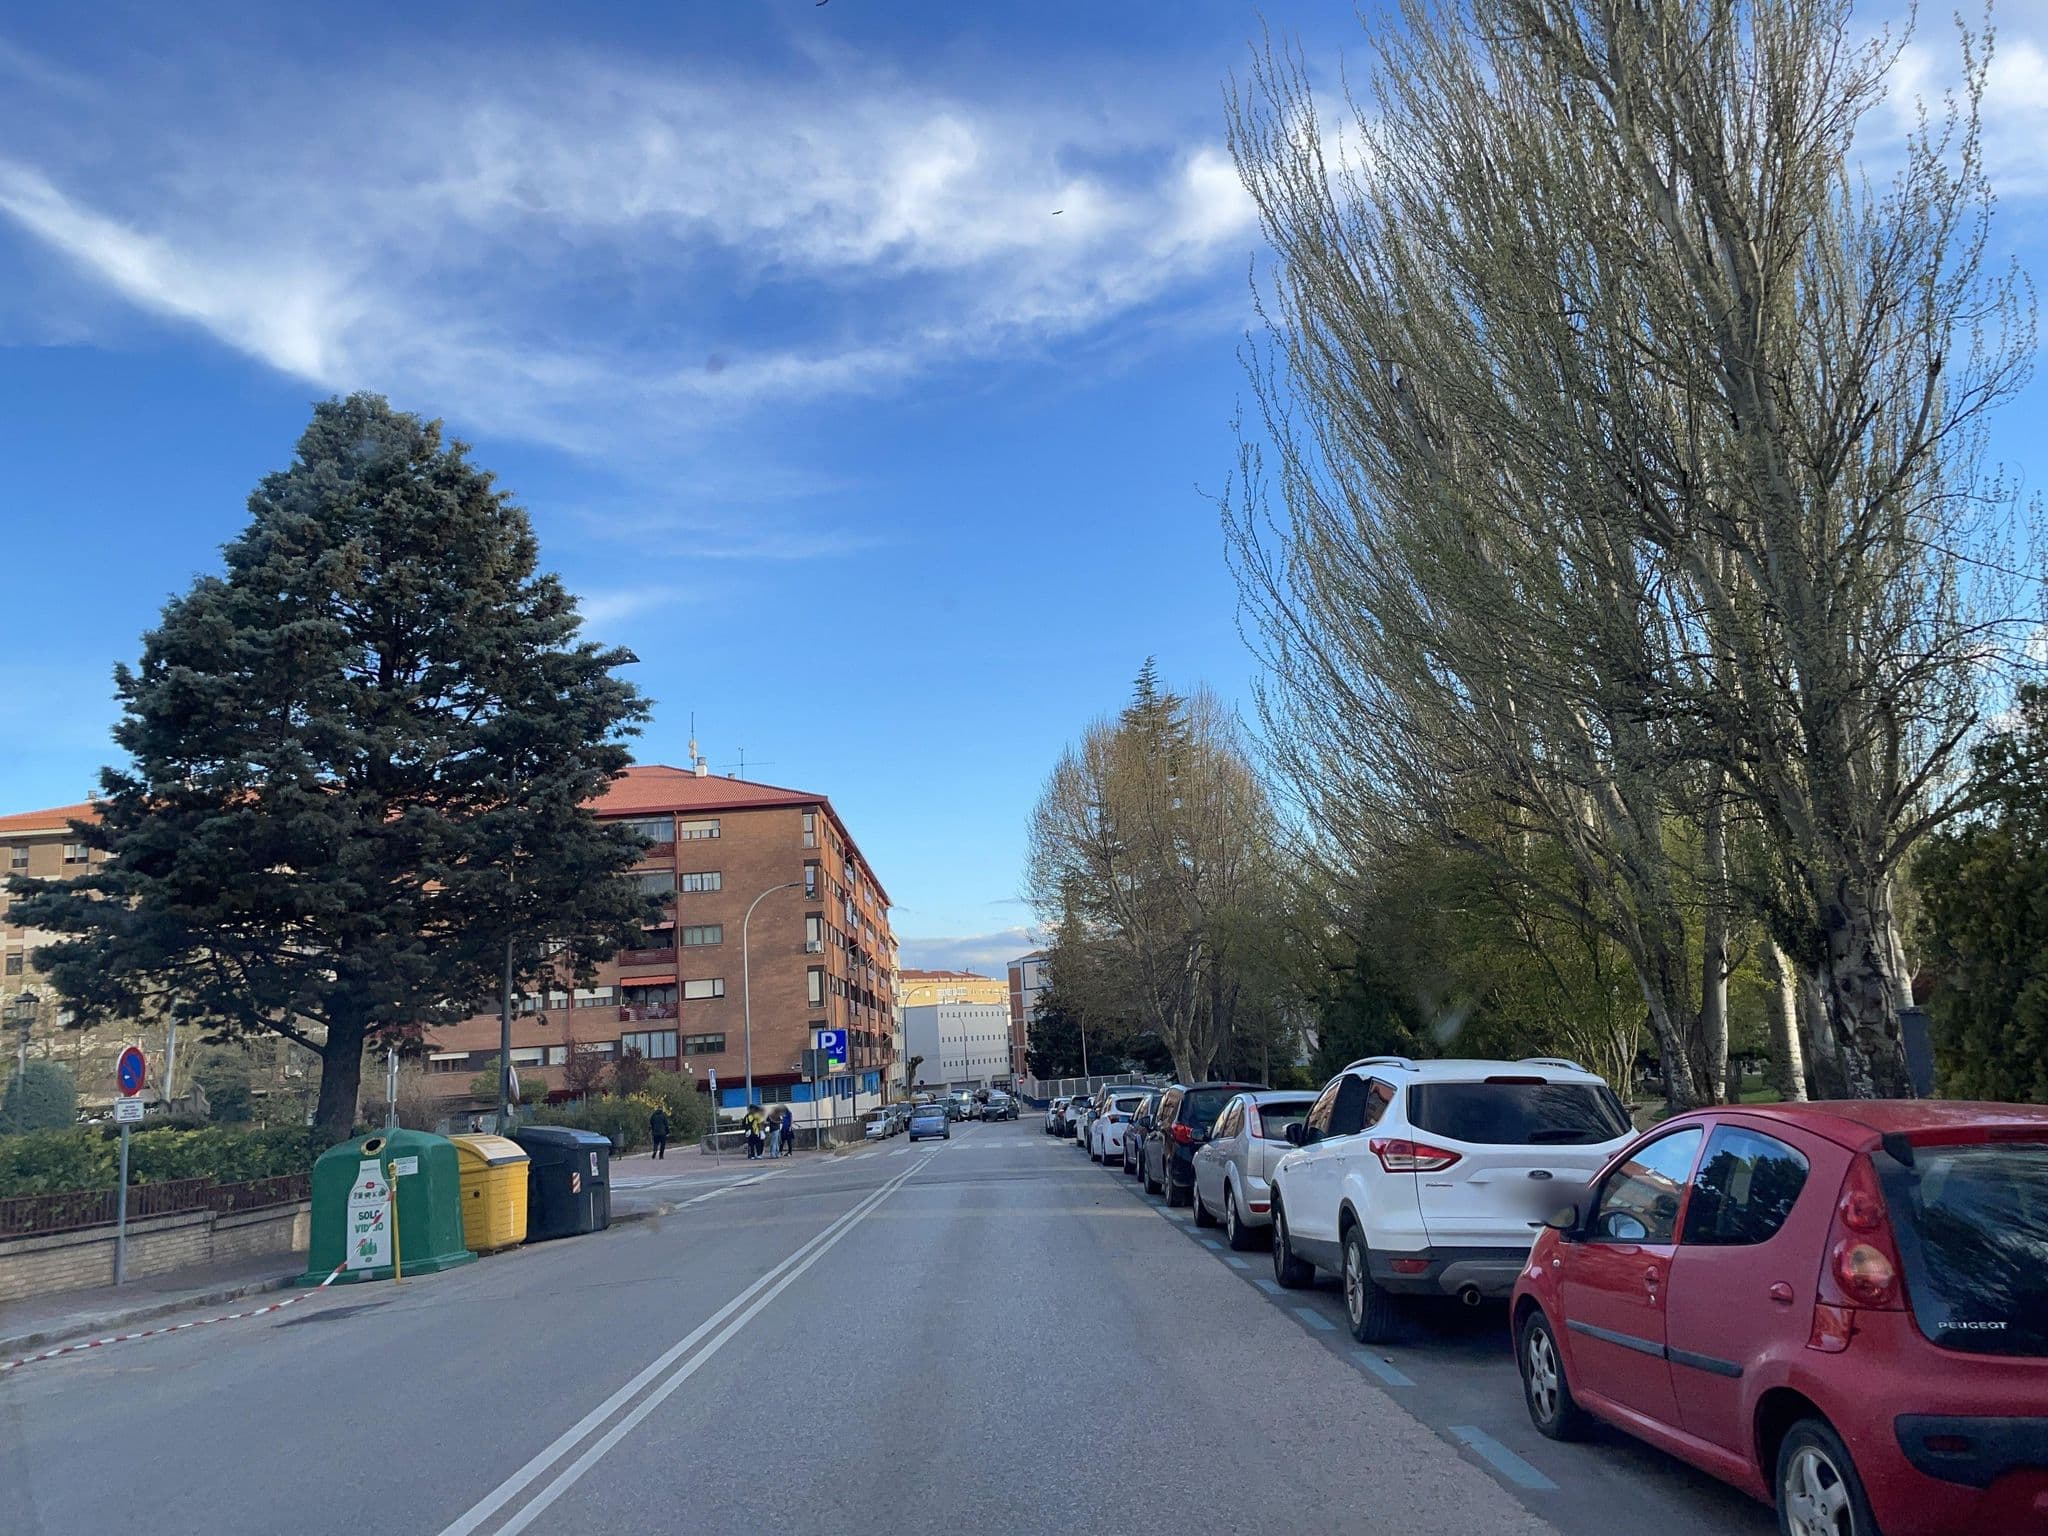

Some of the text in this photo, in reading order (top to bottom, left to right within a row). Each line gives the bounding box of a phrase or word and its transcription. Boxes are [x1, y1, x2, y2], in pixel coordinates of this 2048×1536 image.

[821, 1031, 837, 1049] P
[354, 1222, 384, 1234] VIDIO
[1937, 1321, 2009, 1330] PEUGEOT
